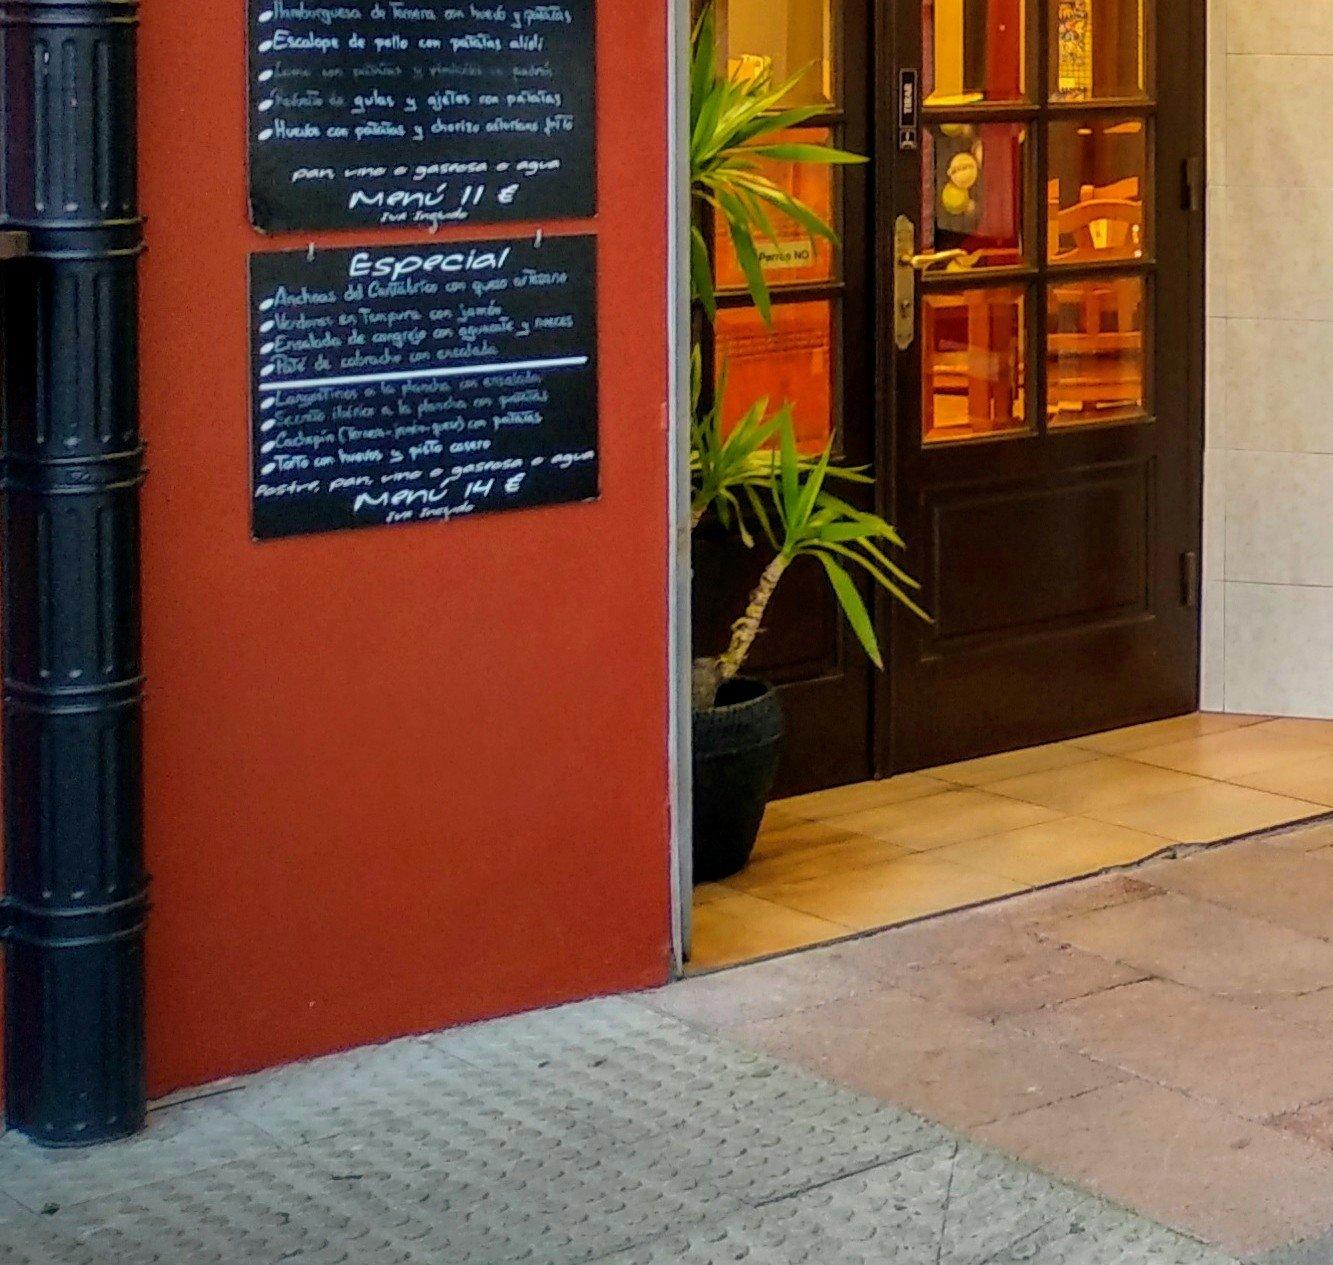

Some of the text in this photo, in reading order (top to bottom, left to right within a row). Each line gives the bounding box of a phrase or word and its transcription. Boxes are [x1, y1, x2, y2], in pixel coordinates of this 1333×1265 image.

[349, 33, 366, 49] de
[374, 34, 409, 52] pollo
[418, 38, 442, 49] con
[350, 89, 395, 114] gulas
[403, 95, 418, 112] y
[479, 94, 499, 106] con
[326, 127, 349, 138] con
[516, 159, 561, 176] agua
[349, 183, 448, 209] Menú
[350, 248, 511, 281] Especial
[794, 249, 809, 260] NO
[550, 450, 595, 470] agua
[464, 478, 495, 498] 14
